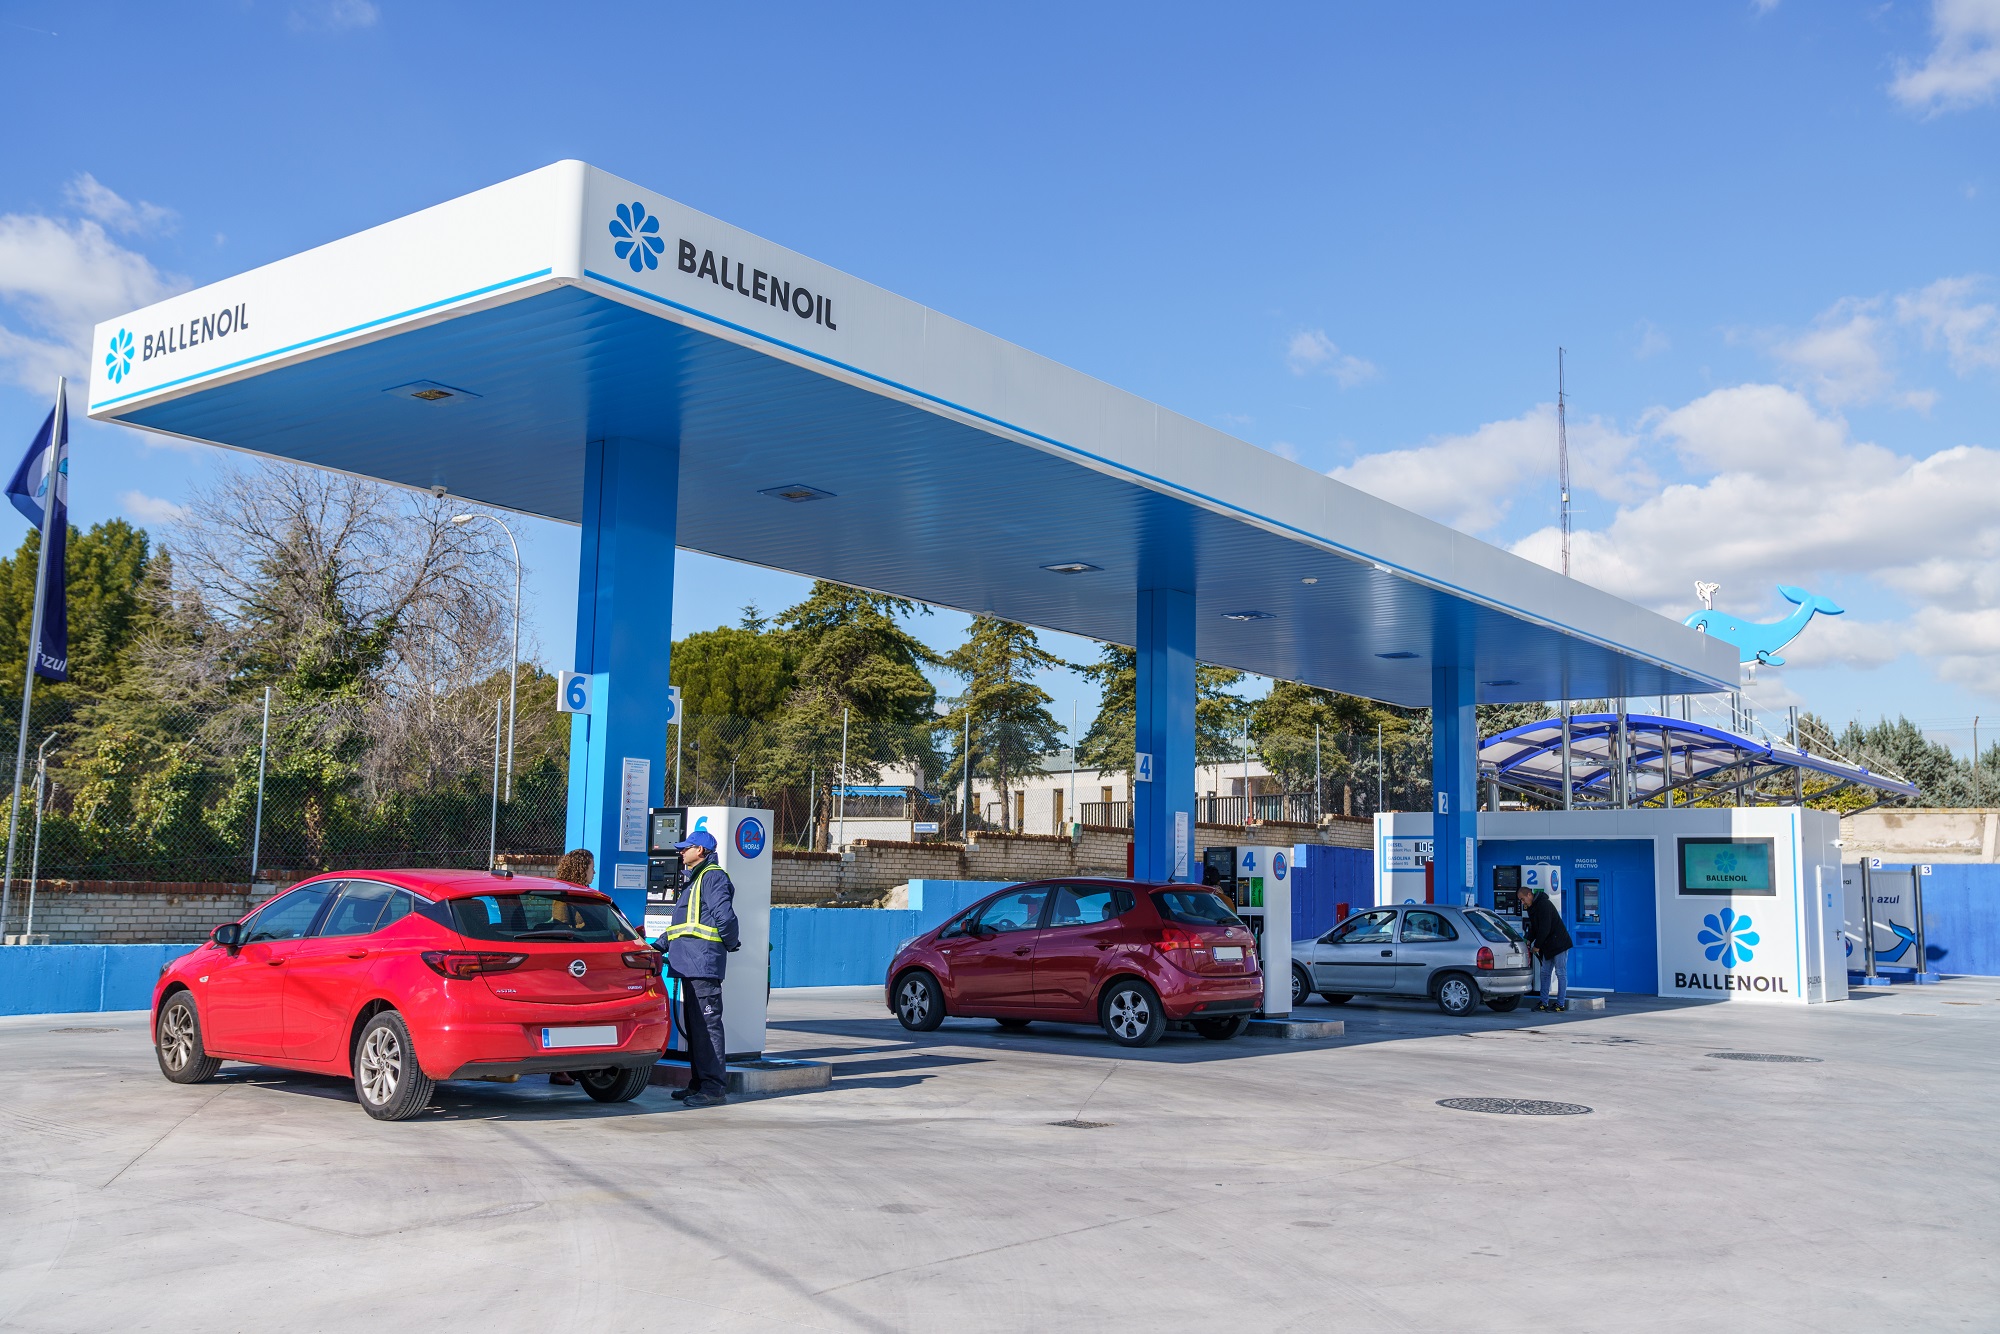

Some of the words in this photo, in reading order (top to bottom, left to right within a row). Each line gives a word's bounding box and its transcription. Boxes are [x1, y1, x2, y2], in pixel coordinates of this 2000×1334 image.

[678, 238, 837, 331] BALLENOIL
[142, 302, 249, 362] BALLENOIL
[566, 675, 587, 710] 6
[1139, 755, 1151, 780] 4
[1441, 794, 1448, 813] 2
[744, 830, 760, 843] 24
[1241, 851, 1256, 872] 4
[1872, 858, 1880, 867] 2
[1923, 866, 1931, 874] 3
[1526, 869, 1538, 885] 2
[1706, 874, 1747, 882] BALLENOIL
[1876, 895, 1900, 904] azul
[1675, 972, 1789, 993] BALLENOIL
